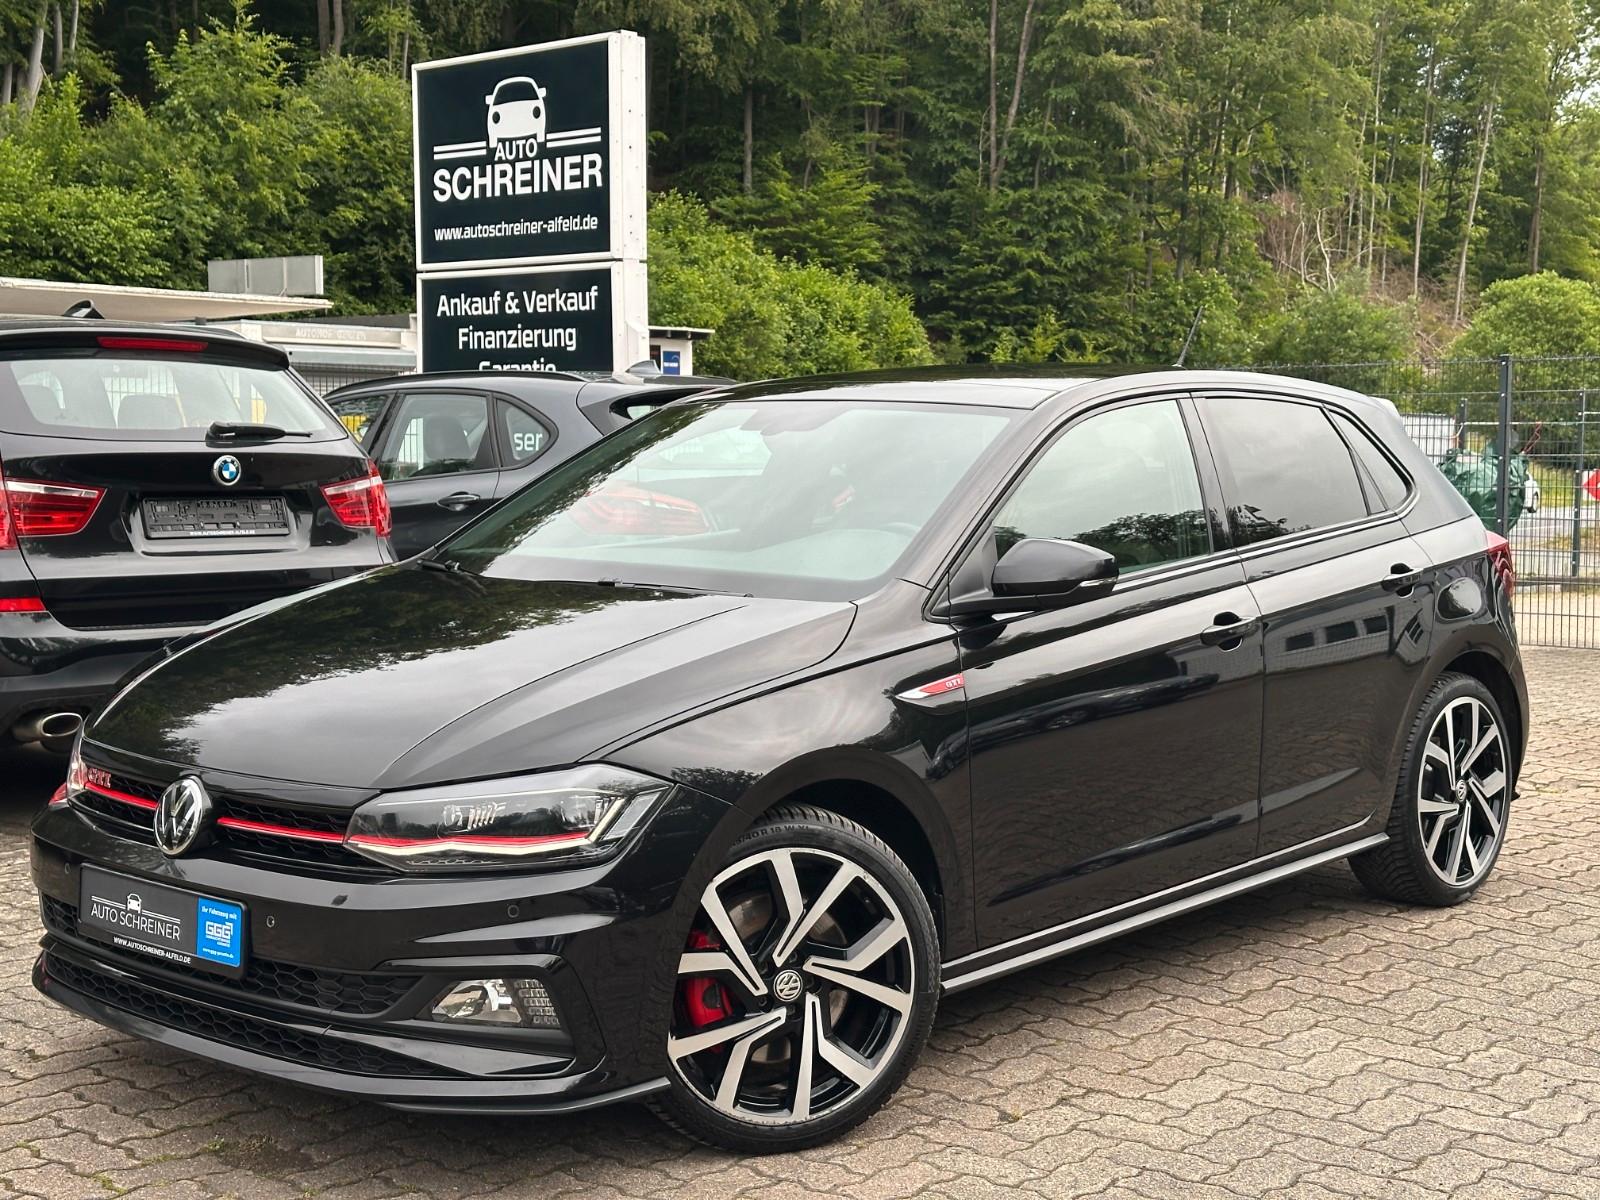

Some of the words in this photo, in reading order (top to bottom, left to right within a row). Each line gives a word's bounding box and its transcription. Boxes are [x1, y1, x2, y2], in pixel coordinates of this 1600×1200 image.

[494, 138, 538, 161] AUTO
[433, 153, 602, 201] SCHREINER
[434, 214, 598, 241] www.autoschreiner-alfeld.de
[437, 290, 501, 317] Ankauf
[505, 291, 520, 314] &
[522, 285, 598, 312] Verkauf
[458, 324, 577, 351] Finanzierung
[944, 679, 962, 688] GTI
[91, 903, 118, 923] AUTO
[119, 911, 180, 941] SCHREINER
[206, 921, 231, 940] GGG
[113, 936, 192, 964] WWW.AUTOSCHREINER-ALFELD.DE
